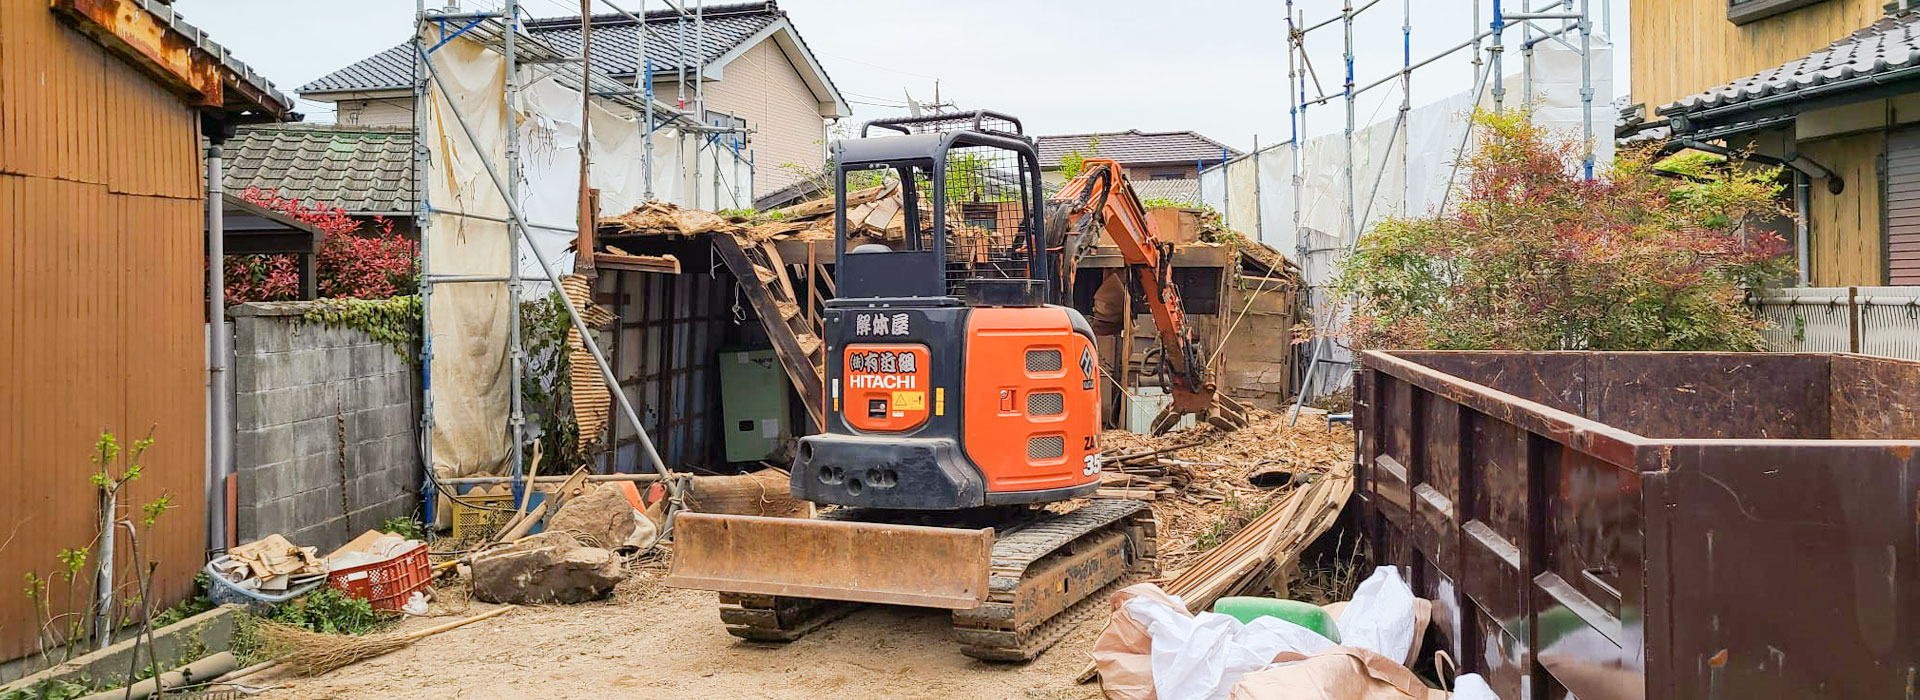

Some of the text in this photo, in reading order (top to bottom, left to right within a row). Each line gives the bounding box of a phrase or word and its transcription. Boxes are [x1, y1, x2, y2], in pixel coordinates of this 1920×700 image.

[856, 313, 910, 336] 解体屋
[850, 375, 916, 389] HITACHI
[1083, 453, 1102, 477] 35
